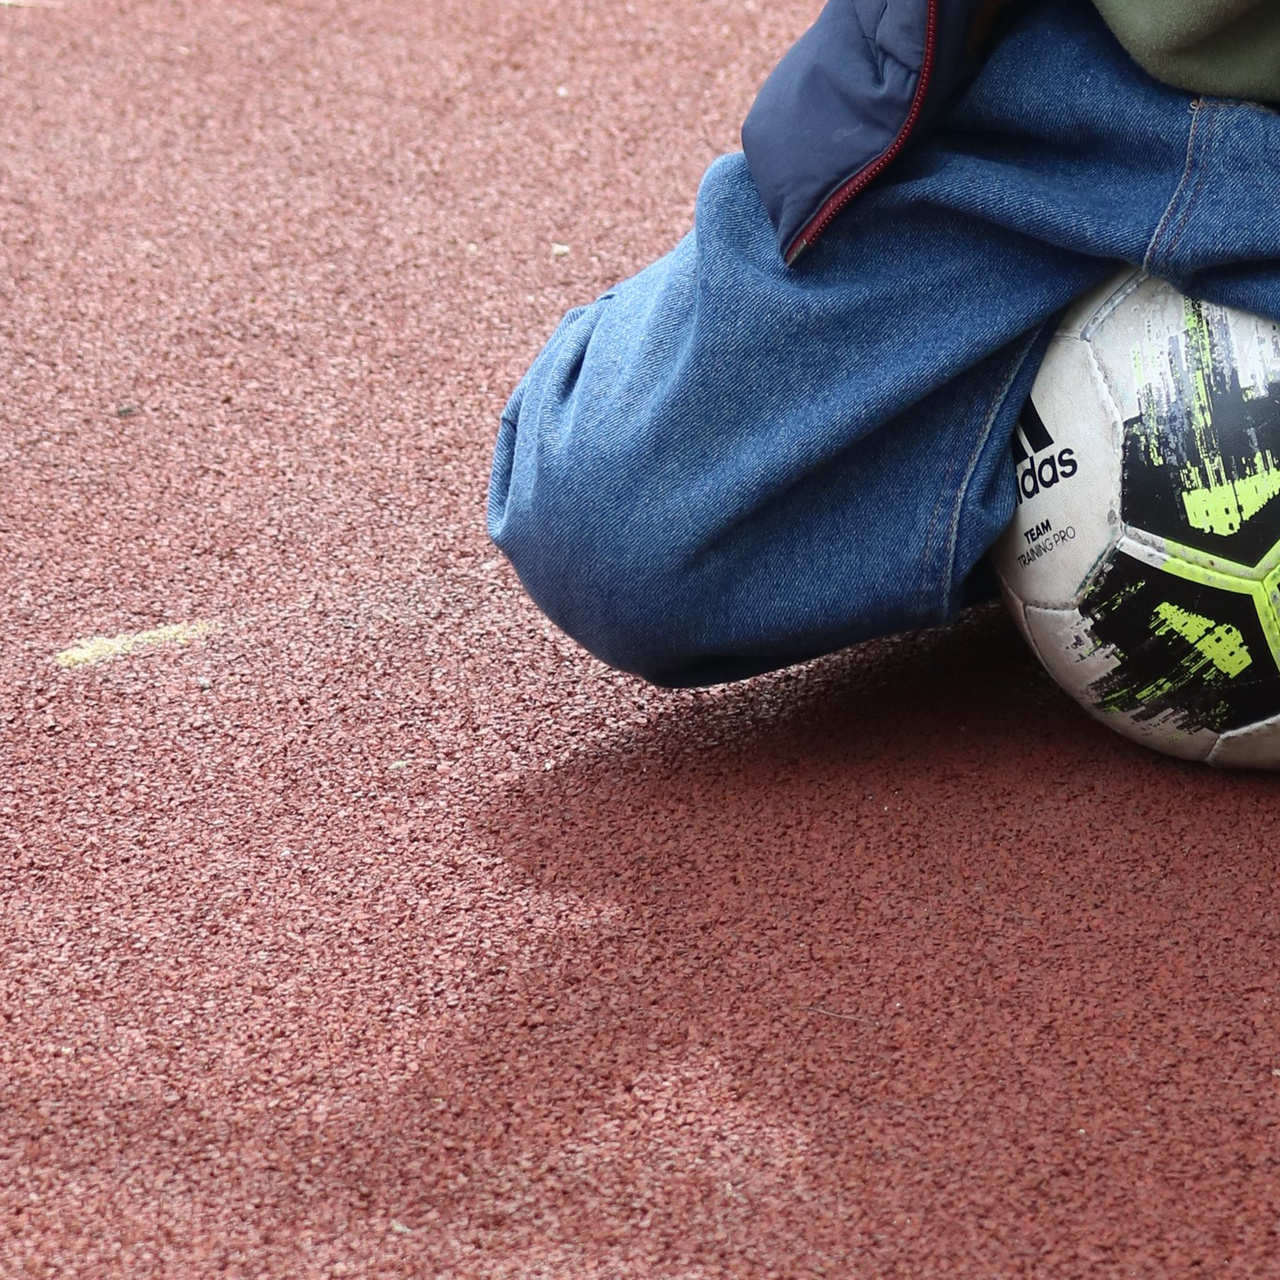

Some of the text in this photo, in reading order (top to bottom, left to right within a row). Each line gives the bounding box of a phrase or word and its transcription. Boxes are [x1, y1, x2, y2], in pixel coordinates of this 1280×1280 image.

[1015, 448, 1078, 506] idas
[1017, 525, 1076, 570] TRAINING PRO
[1024, 519, 1052, 544] TEAM
